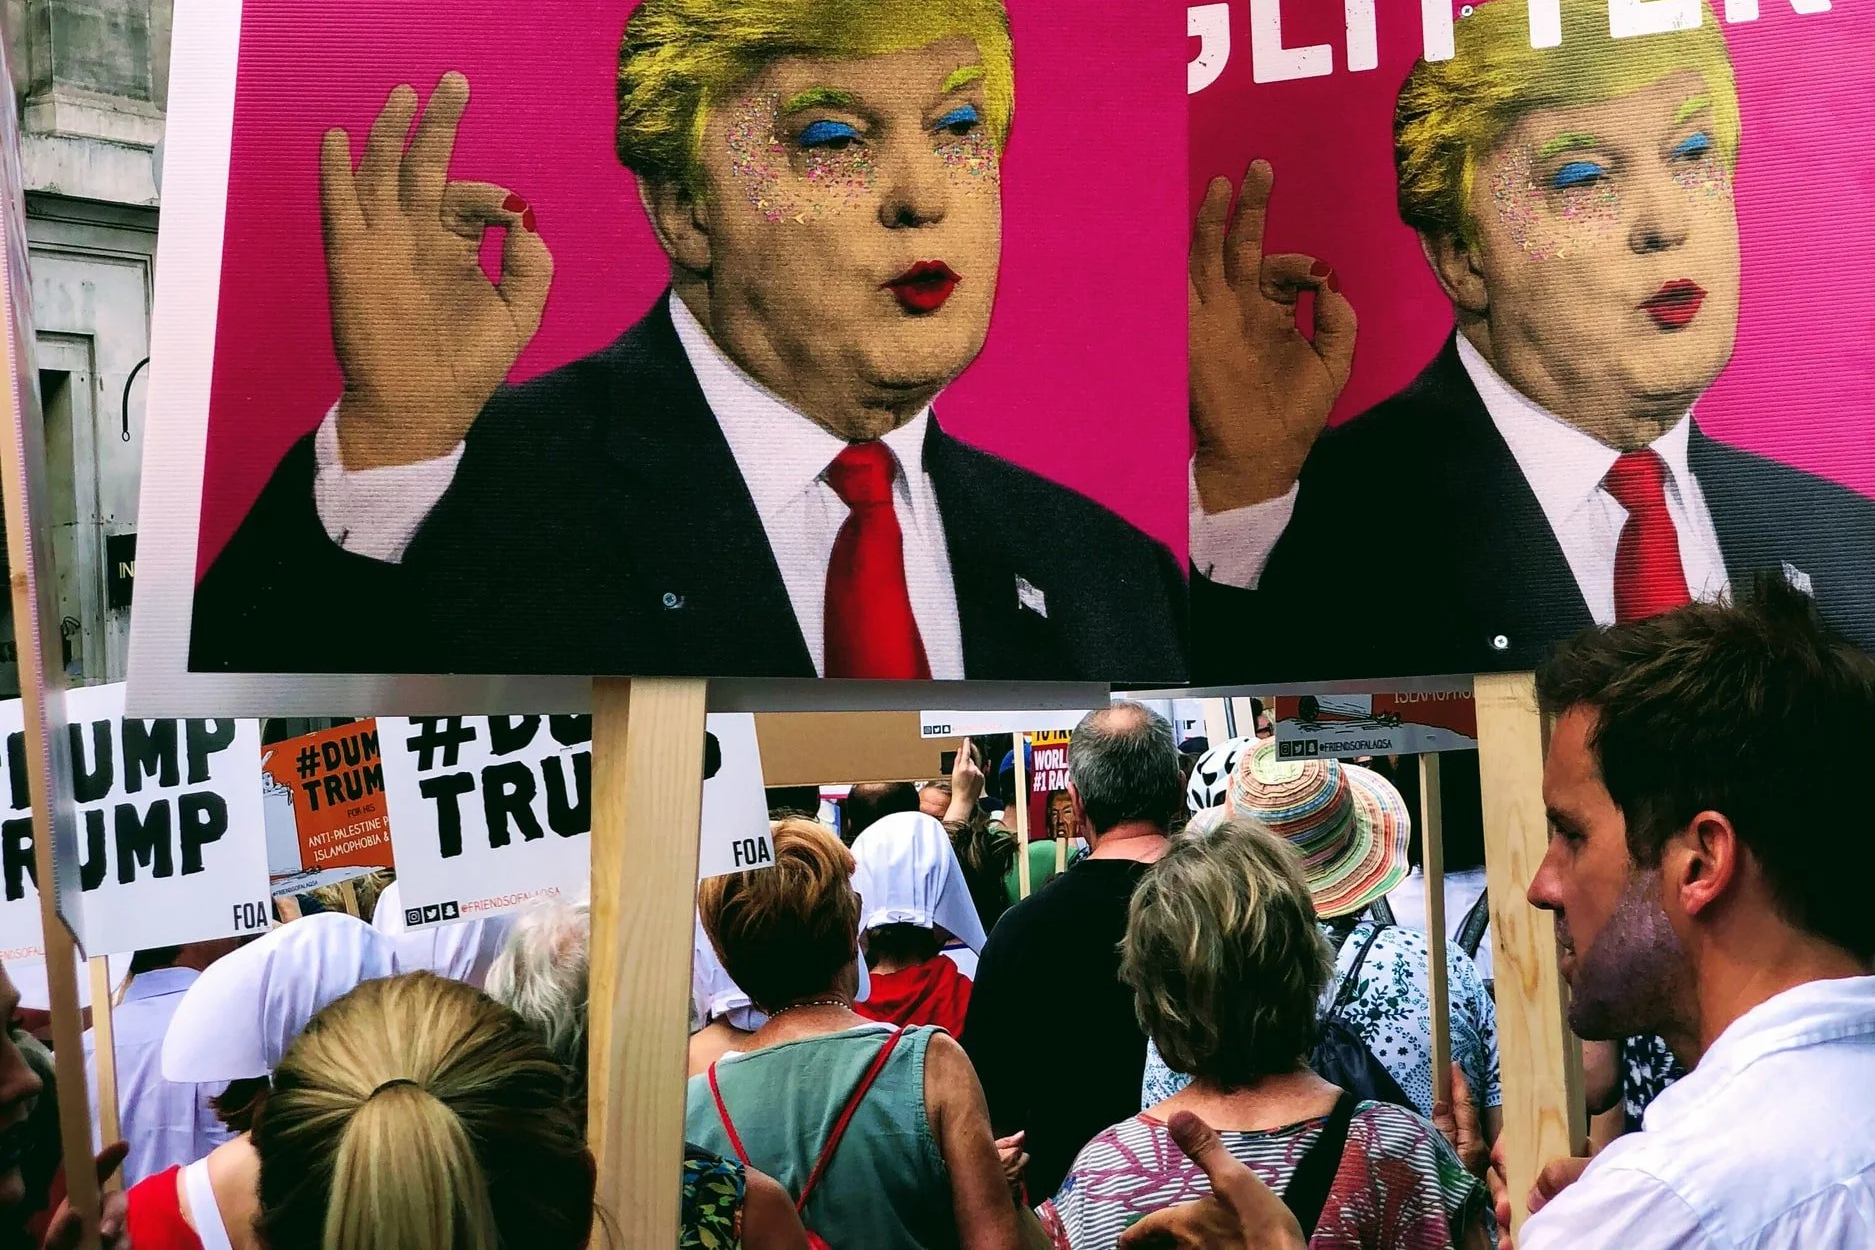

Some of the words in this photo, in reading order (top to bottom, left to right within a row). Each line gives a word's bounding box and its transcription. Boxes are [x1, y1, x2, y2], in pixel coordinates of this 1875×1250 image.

[1394, 690, 1476, 704] ISLAMOPHO
[296, 729, 381, 780] #DUM
[1033, 748, 1069, 771] WORL
[302, 763, 385, 812] TRUM
[1033, 770, 1047, 792] #1
[347, 807, 362, 818] FOR
[362, 803, 376, 814] HIS
[308, 817, 382, 848] ANTI-PALESTINE
[314, 834, 382, 862] ISLAMOPHOBIA
[383, 830, 390, 842] &
[732, 836, 771, 868] FOA
[233, 901, 268, 930] FOA
